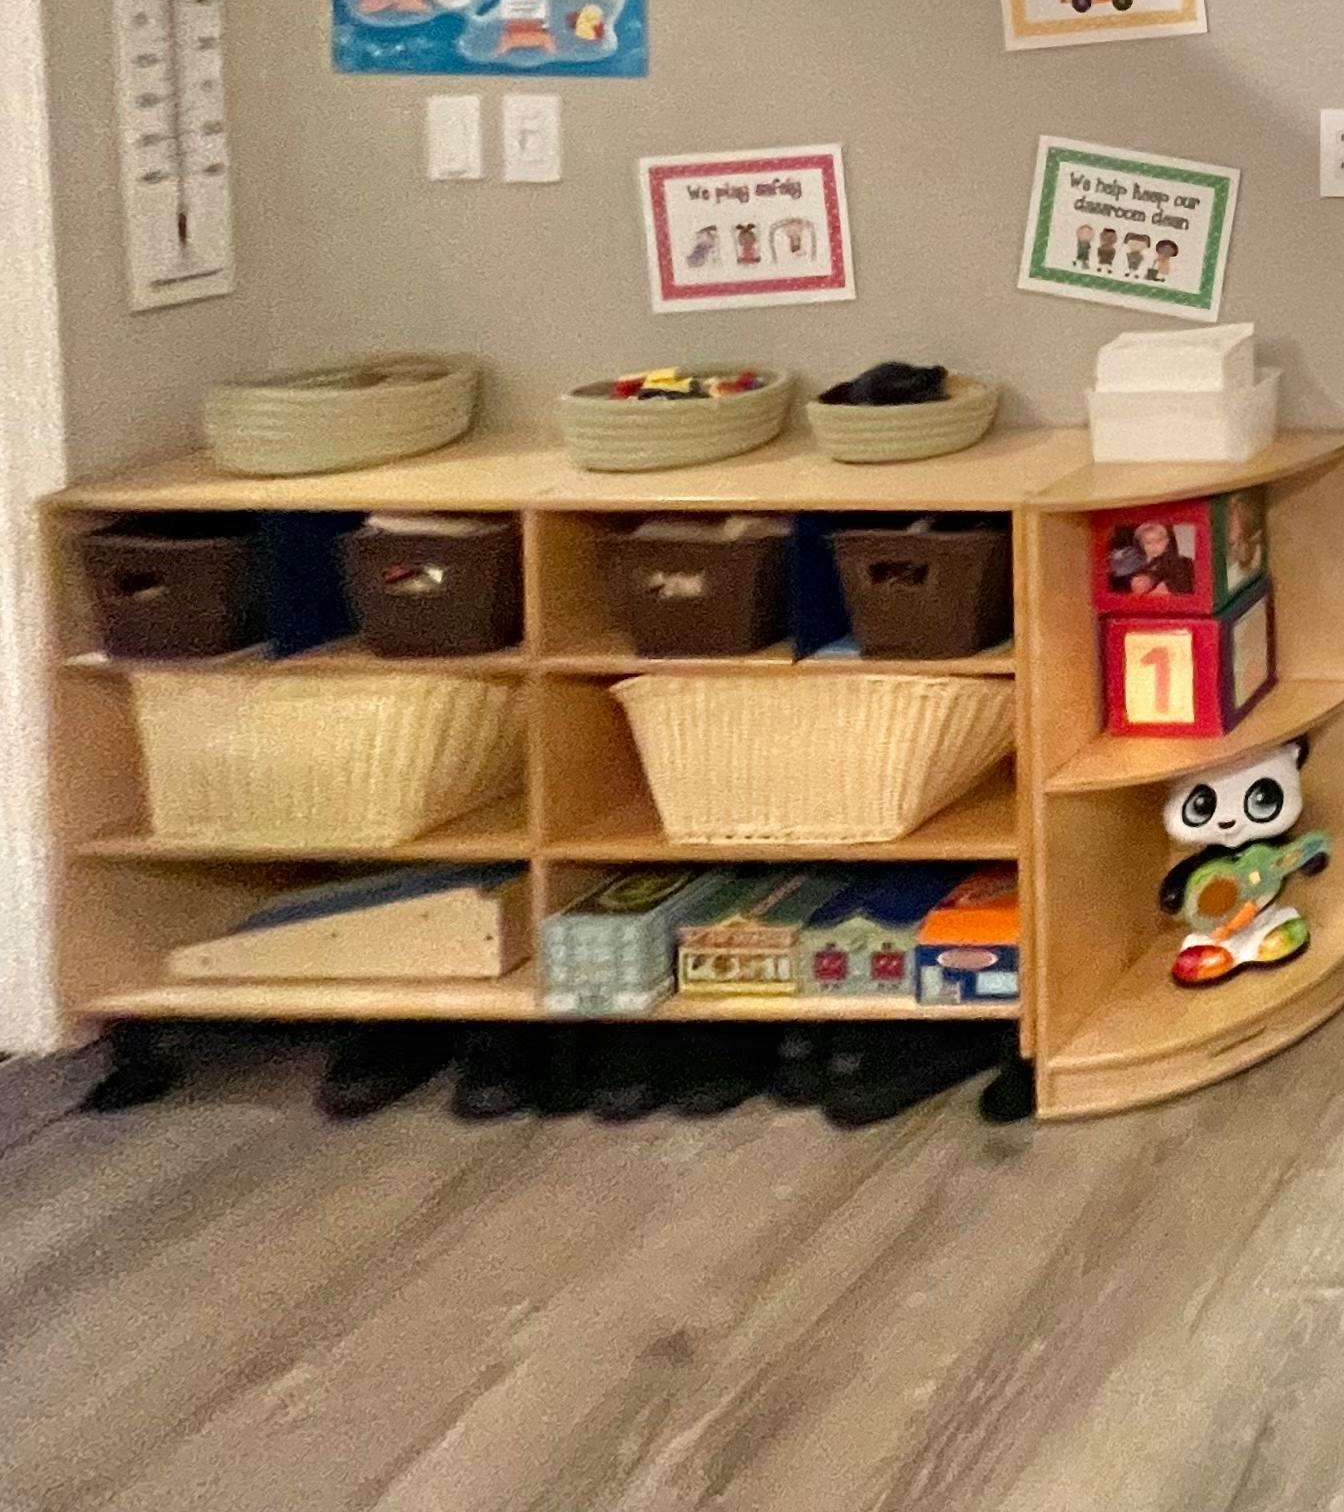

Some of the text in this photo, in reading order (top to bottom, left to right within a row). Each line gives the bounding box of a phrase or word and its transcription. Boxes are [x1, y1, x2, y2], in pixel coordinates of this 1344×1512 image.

[687, 185, 710, 200] We
[1070, 172, 1200, 210] We help keep our
[1074, 195, 1189, 231] classroom clean
[1140, 645, 1173, 713] 1
